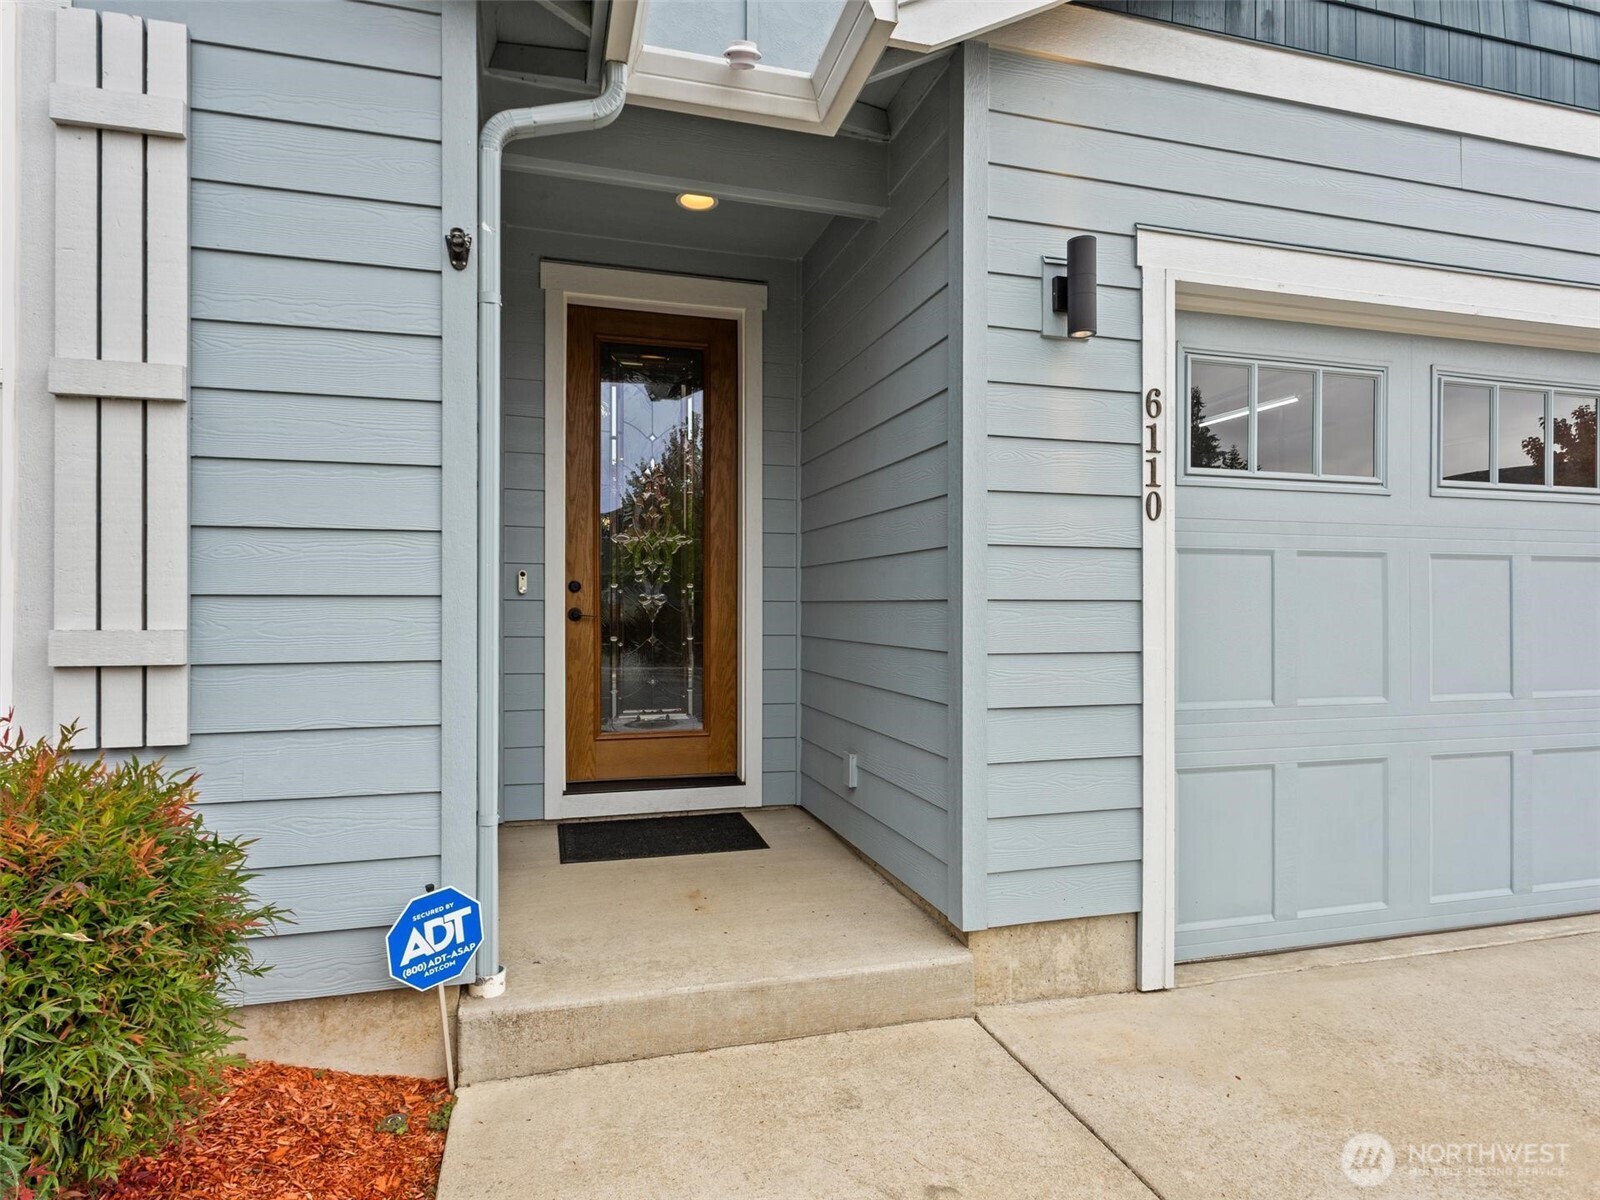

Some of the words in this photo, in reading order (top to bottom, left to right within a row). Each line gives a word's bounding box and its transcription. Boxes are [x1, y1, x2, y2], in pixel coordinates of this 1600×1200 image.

[1145, 388, 1162, 521] 6110
[412, 906, 444, 921] SECURED
[445, 902, 454, 910] BY
[400, 906, 472, 967] ADT
[402, 961, 427, 979] (800)
[428, 942, 476, 968] ADT-ASAP
[424, 960, 456, 977] ADT.COM
